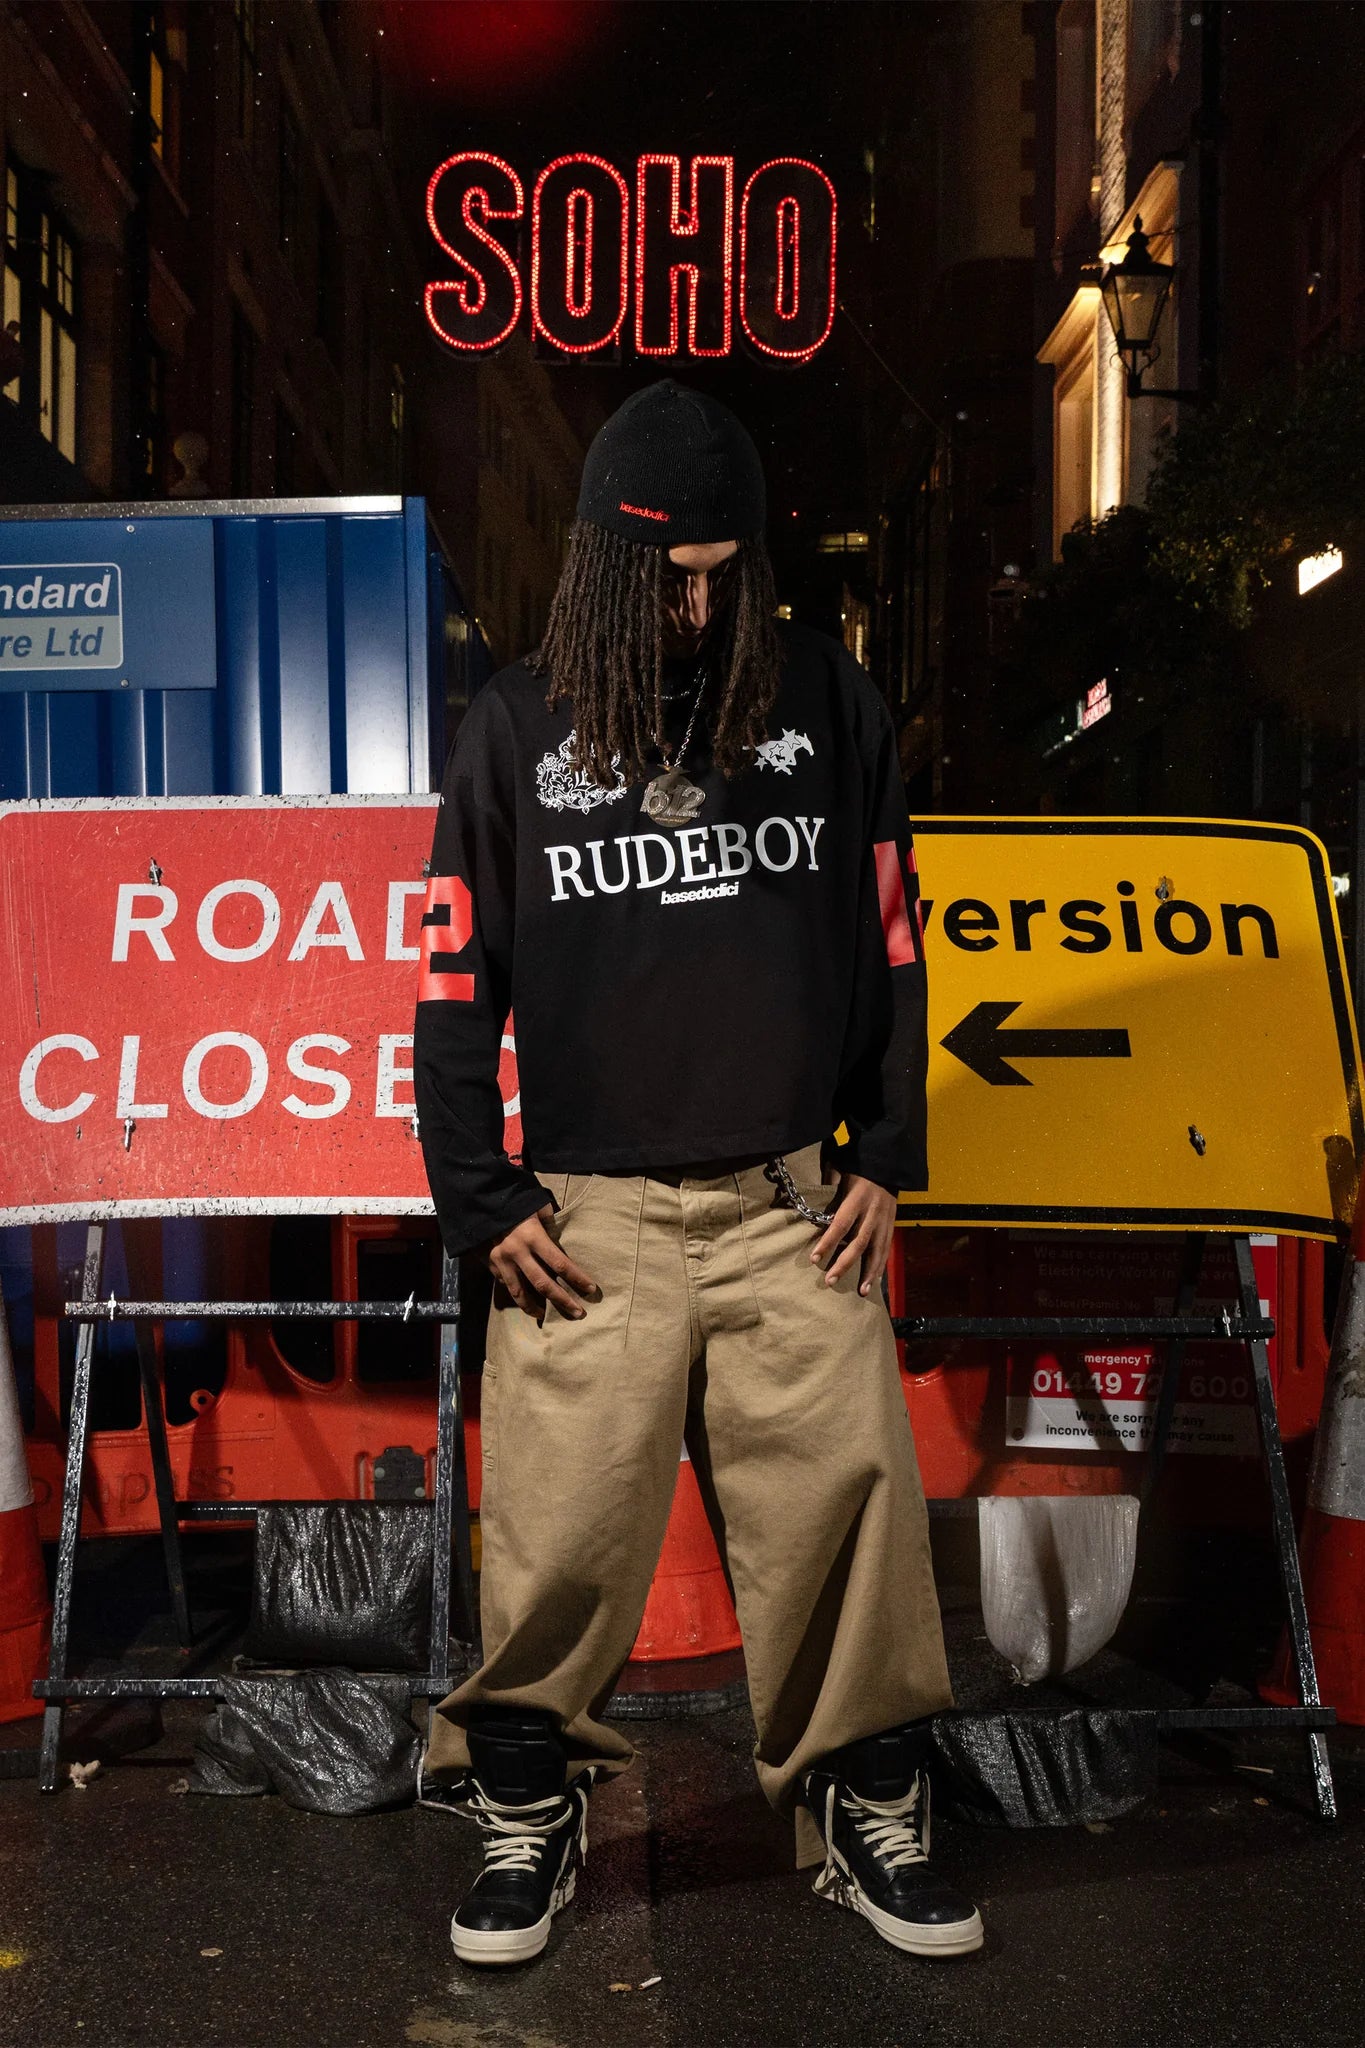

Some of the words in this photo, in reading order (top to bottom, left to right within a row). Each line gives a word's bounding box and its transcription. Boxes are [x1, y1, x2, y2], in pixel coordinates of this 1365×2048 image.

[425, 152, 837, 362] SOHO
[45, 626, 104, 656] Ltd
[544, 815, 825, 902] RUDEBOY
[660, 881, 739, 905] basedodici
[418, 875, 475, 1002] 2
[18, 1031, 523, 1124] CLOSE
[1078, 1352, 1141, 1367] Emergency
[1046, 1424, 1136, 1439] inconvenience
[1075, 1410, 1095, 1422] We
[1101, 1414, 1119, 1423] are
